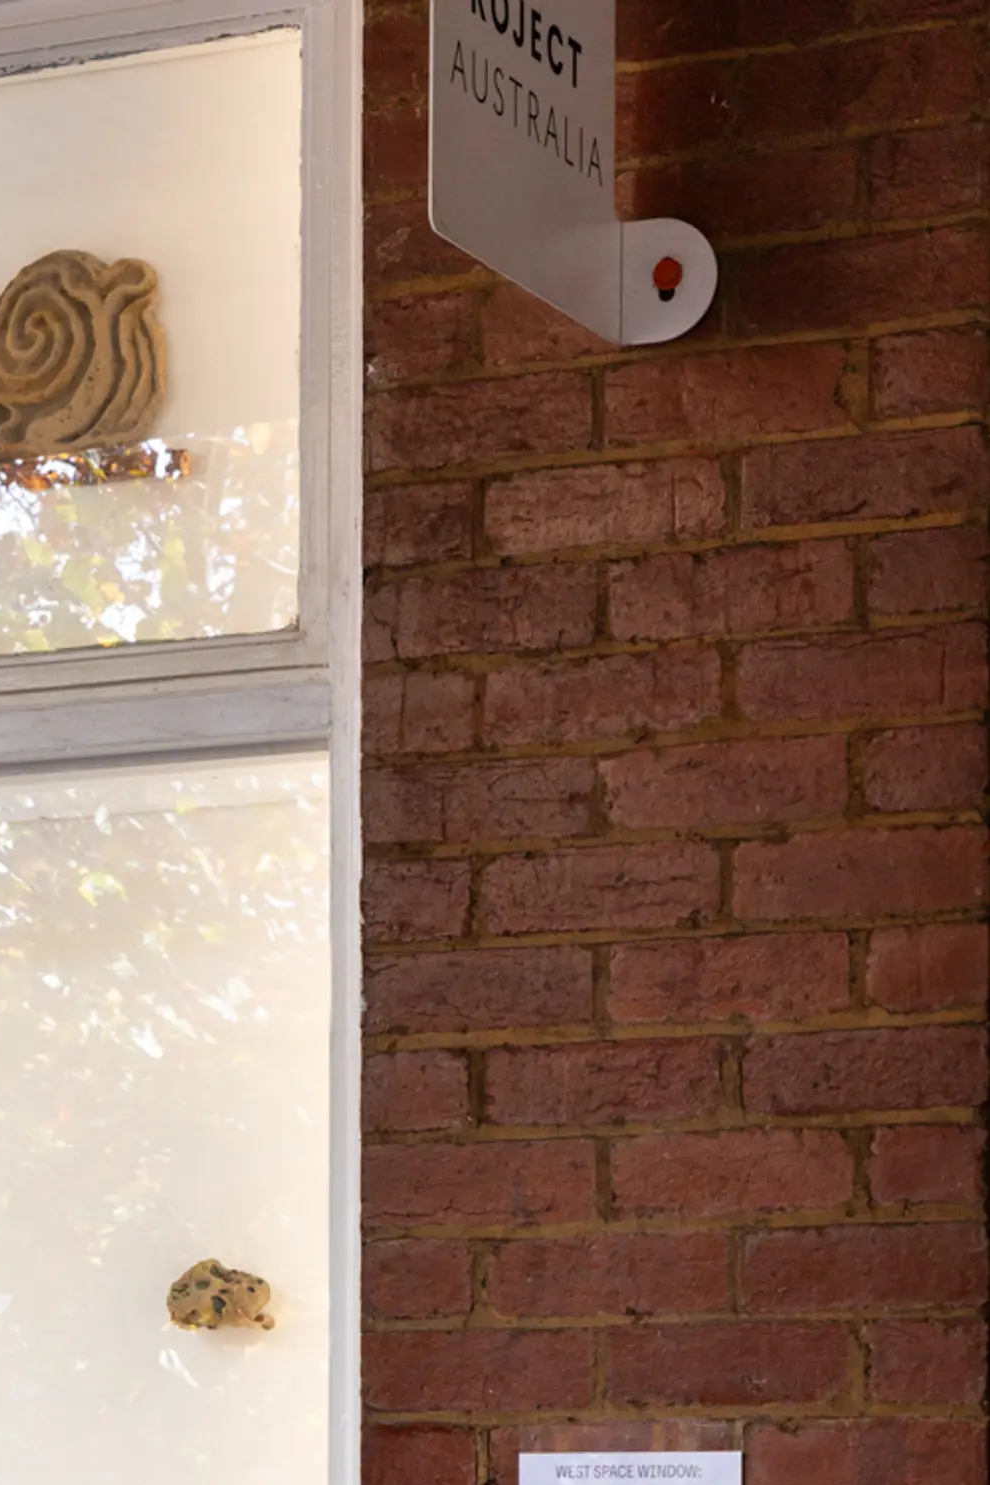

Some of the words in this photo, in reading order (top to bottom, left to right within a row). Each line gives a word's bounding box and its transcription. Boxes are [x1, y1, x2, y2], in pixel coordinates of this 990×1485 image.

[450, 40, 603, 187] AUSTRALIA
[555, 1464, 590, 1479] WEST
[594, 1464, 634, 1479] SPACE
[637, 1464, 702, 1479] WINDOW:
